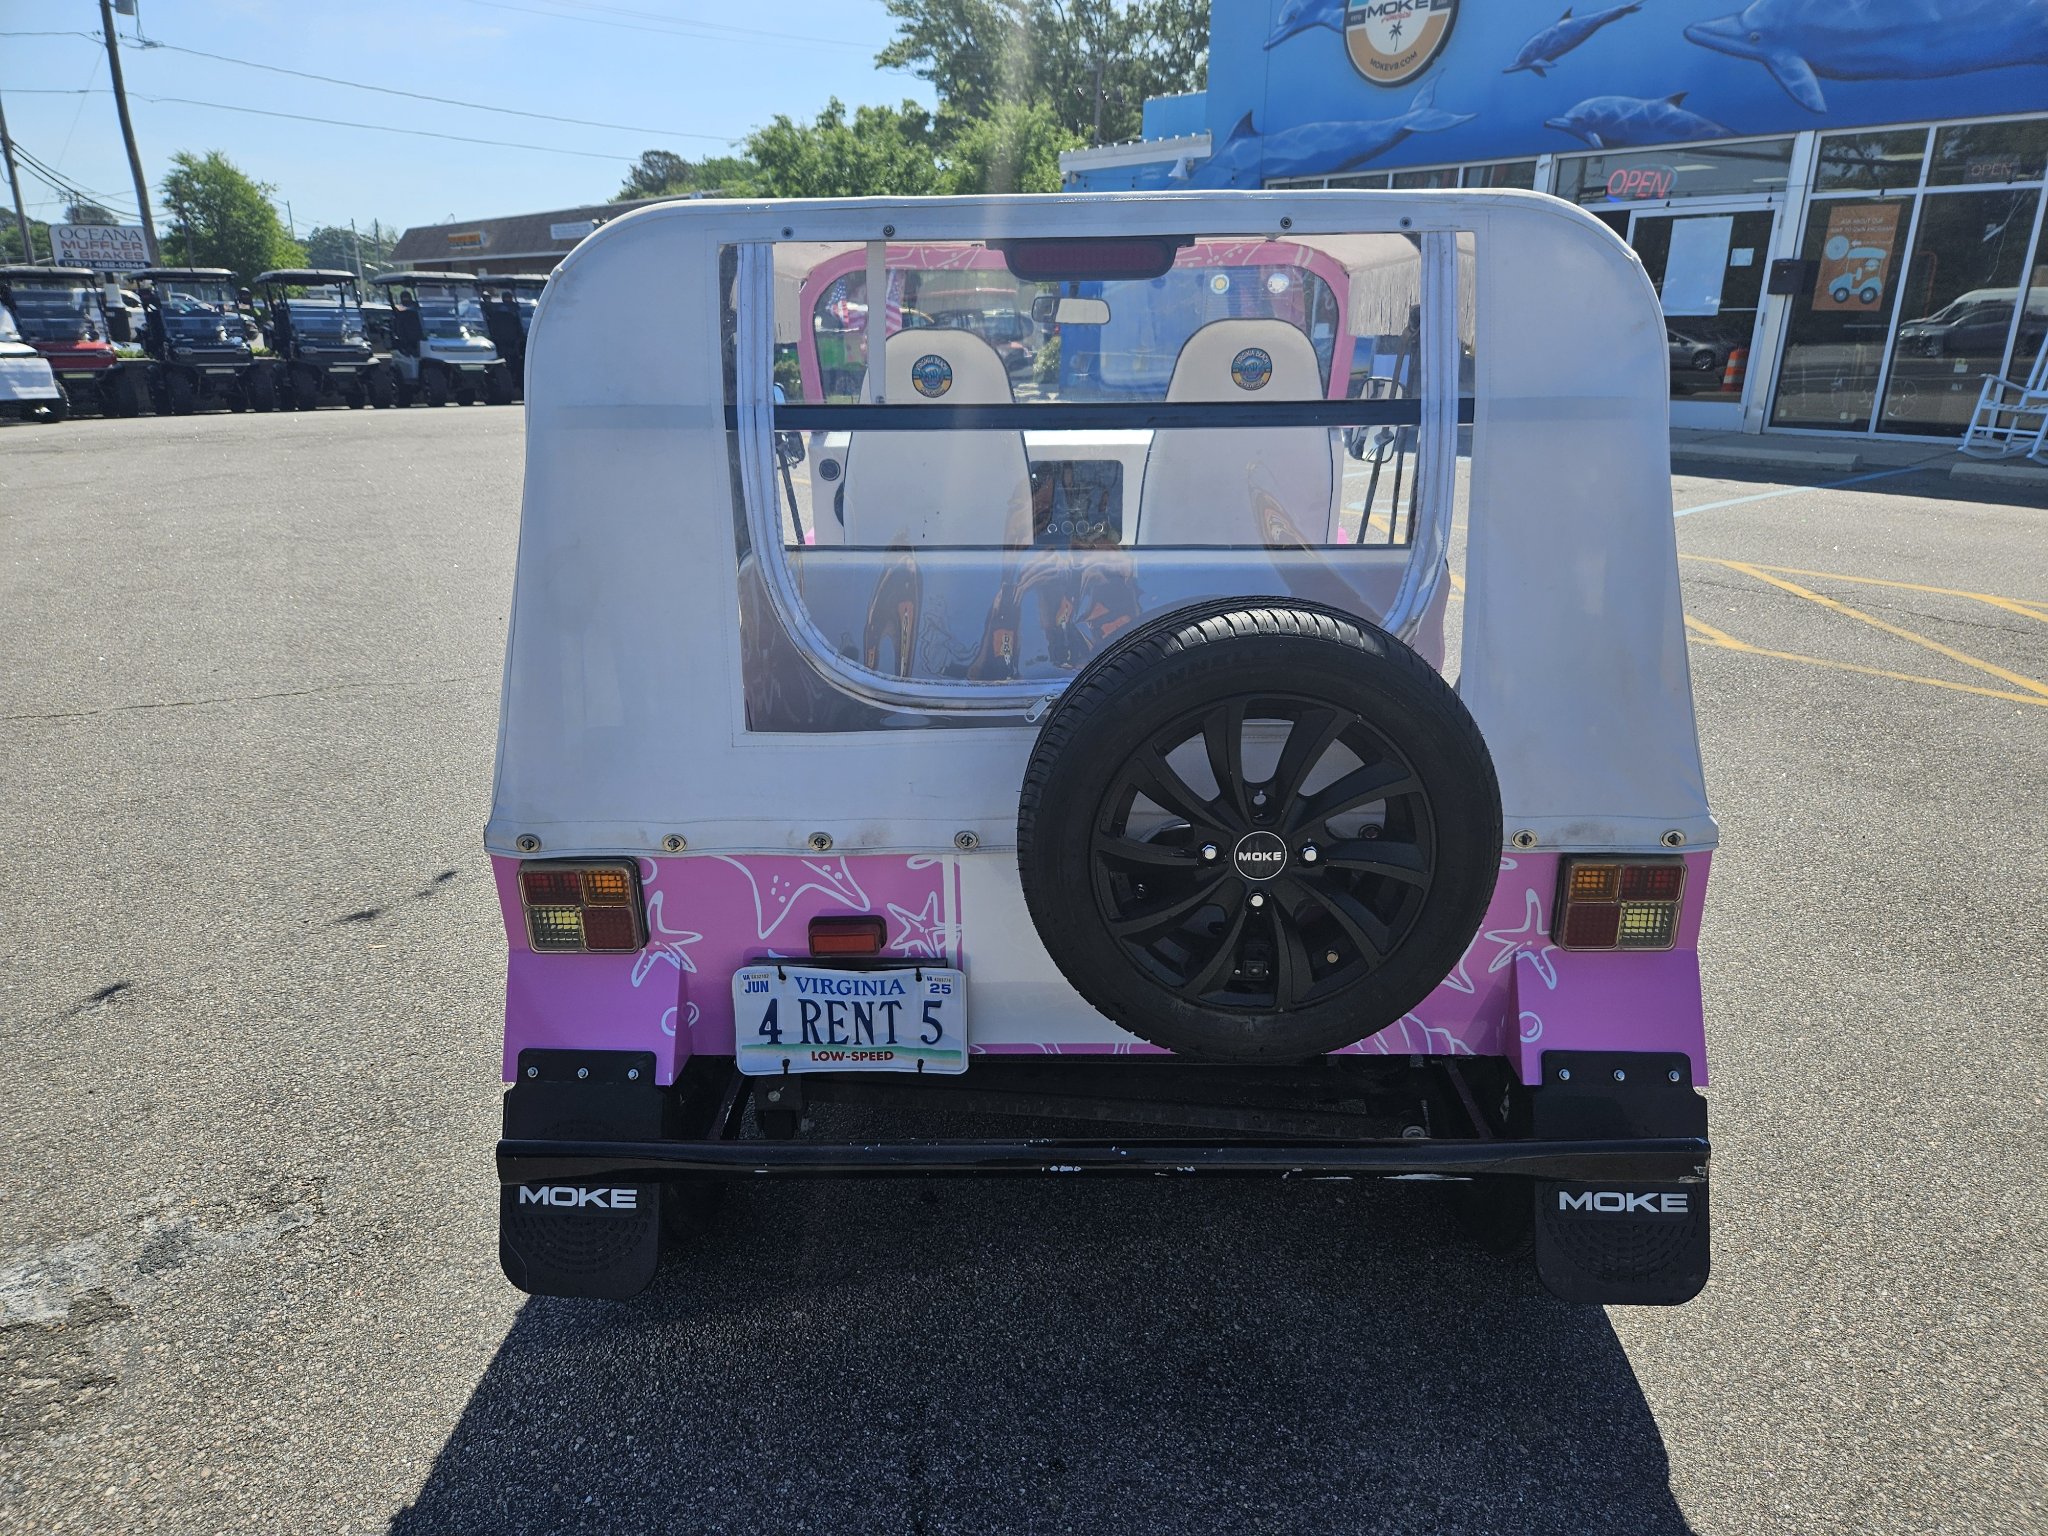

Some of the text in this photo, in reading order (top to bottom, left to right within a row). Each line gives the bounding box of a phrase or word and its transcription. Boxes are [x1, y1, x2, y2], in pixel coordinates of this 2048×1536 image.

[1367, 0, 1429, 18] MOKE
[1369, 51, 1418, 71] MOKEVB.COM
[1971, 162, 2012, 176] OPEN
[1607, 168, 1672, 199] OPEN
[58, 227, 142, 241] OCEANA
[61, 240, 143, 251] MUFFLER
[63, 250, 145, 260] & BRAKES
[64, 260, 93, 268] (757)
[1238, 851, 1282, 861] MOKE
[744, 980, 769, 993] JUN
[794, 976, 906, 996] VIRGINIA
[930, 983, 952, 994] 25
[758, 998, 944, 1046] 4 RENT 5
[811, 1051, 895, 1062] LOW-SPEED
[519, 1185, 638, 1209] MOKE
[1558, 1191, 1689, 1213] MOKE
